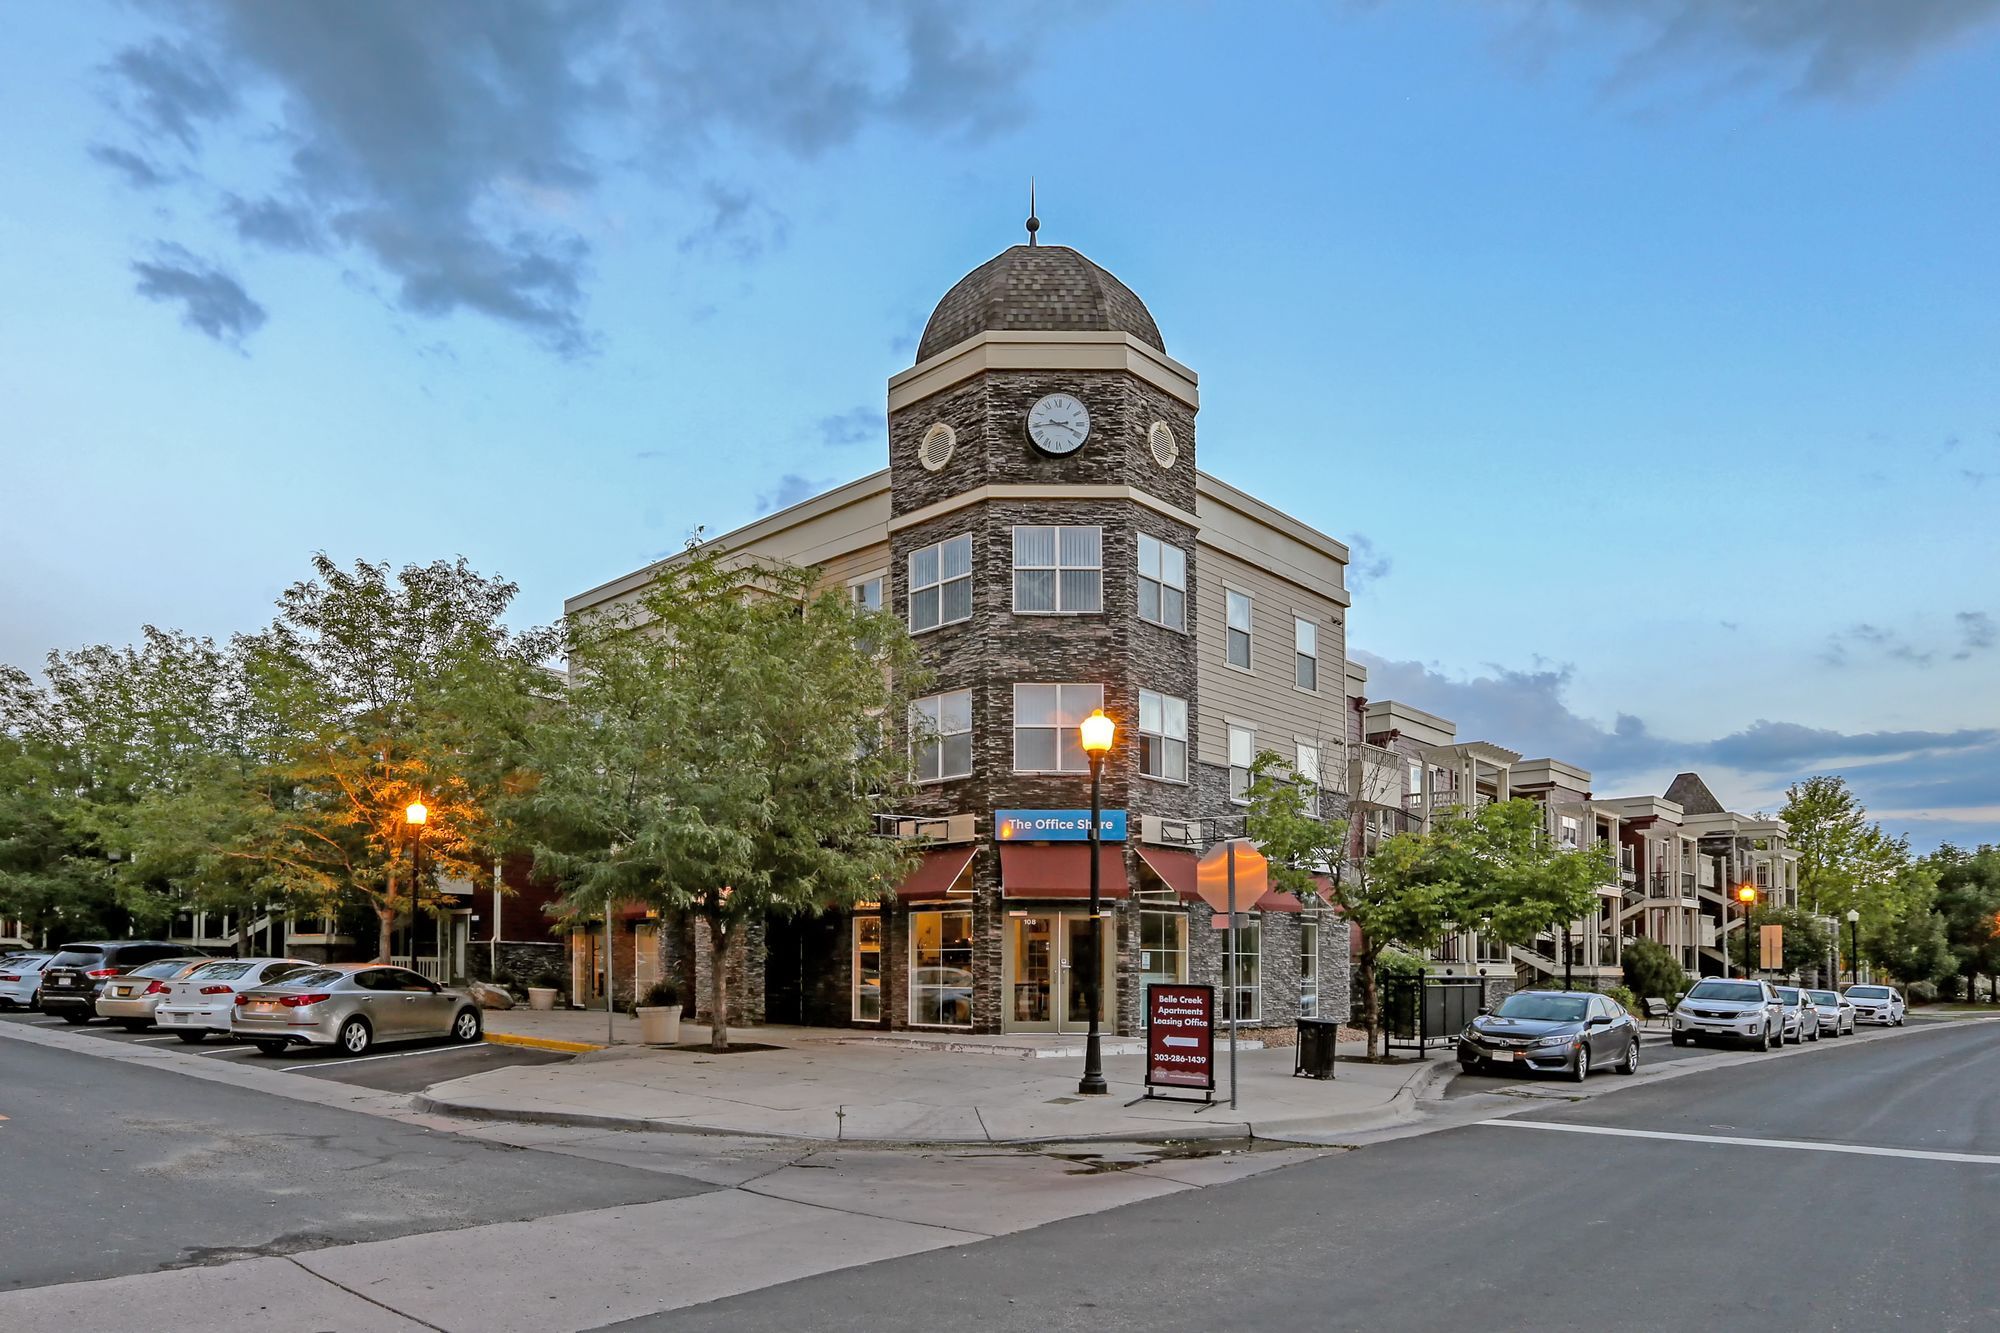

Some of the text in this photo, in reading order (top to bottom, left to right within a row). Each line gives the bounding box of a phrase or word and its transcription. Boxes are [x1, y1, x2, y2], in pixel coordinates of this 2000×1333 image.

[1008, 818, 1114, 830] The Office Shre
[1159, 995, 1203, 1004] Belle Creek
[1158, 1006, 1203, 1016] Apartments
[1153, 1016, 1208, 1027] Leasing Office
[1154, 1053, 1207, 1064] 303-286-1439
